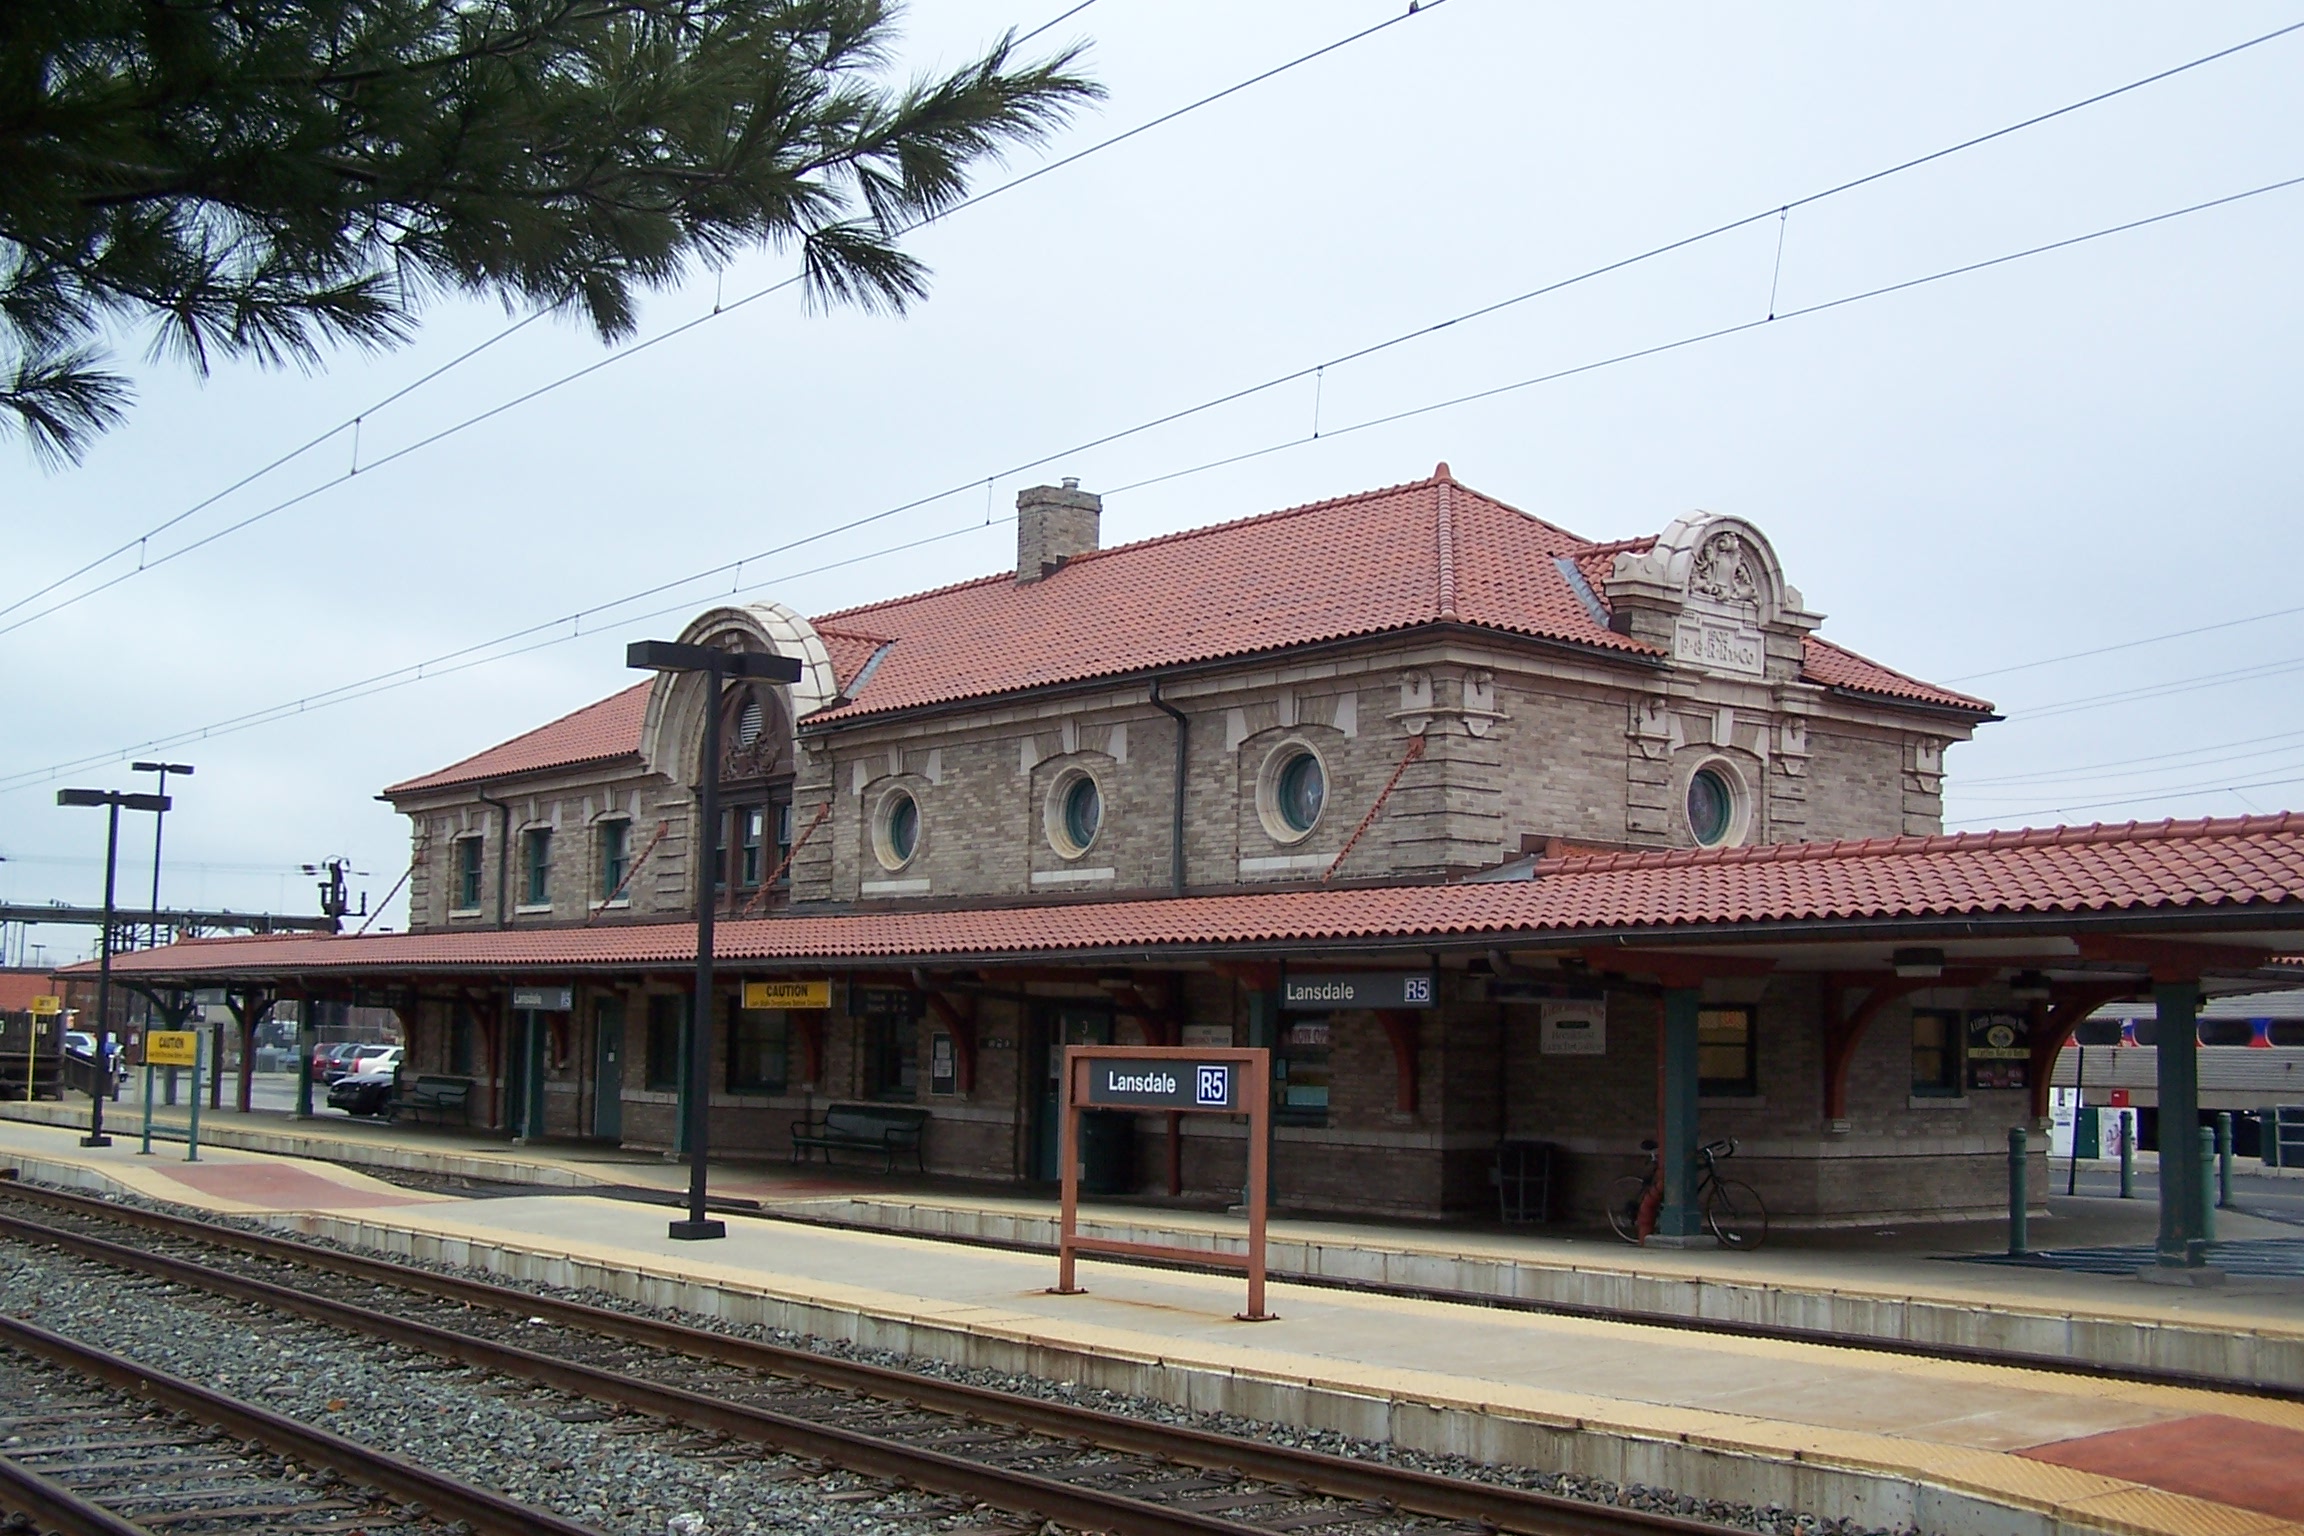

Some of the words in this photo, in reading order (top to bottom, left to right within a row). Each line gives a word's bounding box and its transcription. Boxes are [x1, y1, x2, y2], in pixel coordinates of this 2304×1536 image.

[766, 985, 808, 997] CAUTION
[1287, 982, 1354, 1001] Lansdale
[1406, 981, 1428, 999] R5
[1109, 1070, 1176, 1094] Lansdale
[1201, 1071, 1224, 1100] R5
